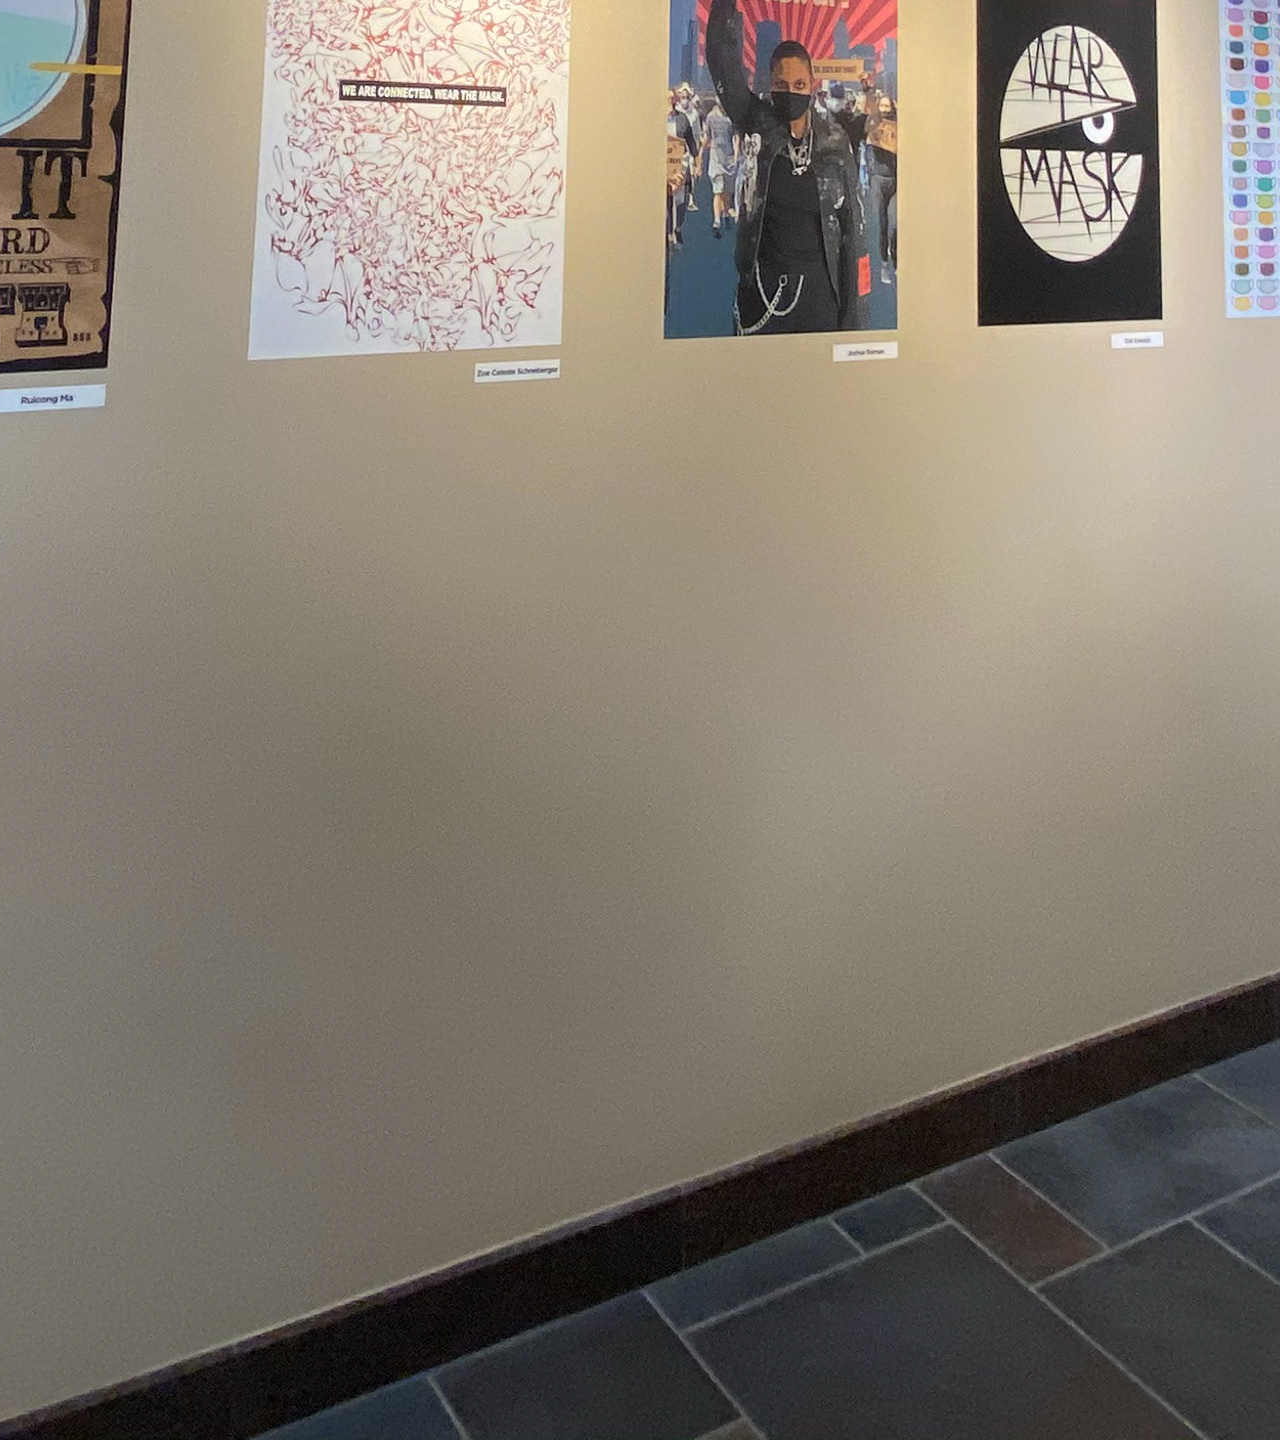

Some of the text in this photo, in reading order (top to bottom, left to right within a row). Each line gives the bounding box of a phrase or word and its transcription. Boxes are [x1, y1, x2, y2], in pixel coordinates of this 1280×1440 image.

[342, 84, 357, 97] WE
[358, 85, 376, 98] ARE
[434, 88, 459, 100] WEAR
[460, 89, 477, 101] THE
[1027, 26, 1110, 105] WEAR
[11, 149, 89, 220] IT
[1019, 149, 1131, 242] MASK
